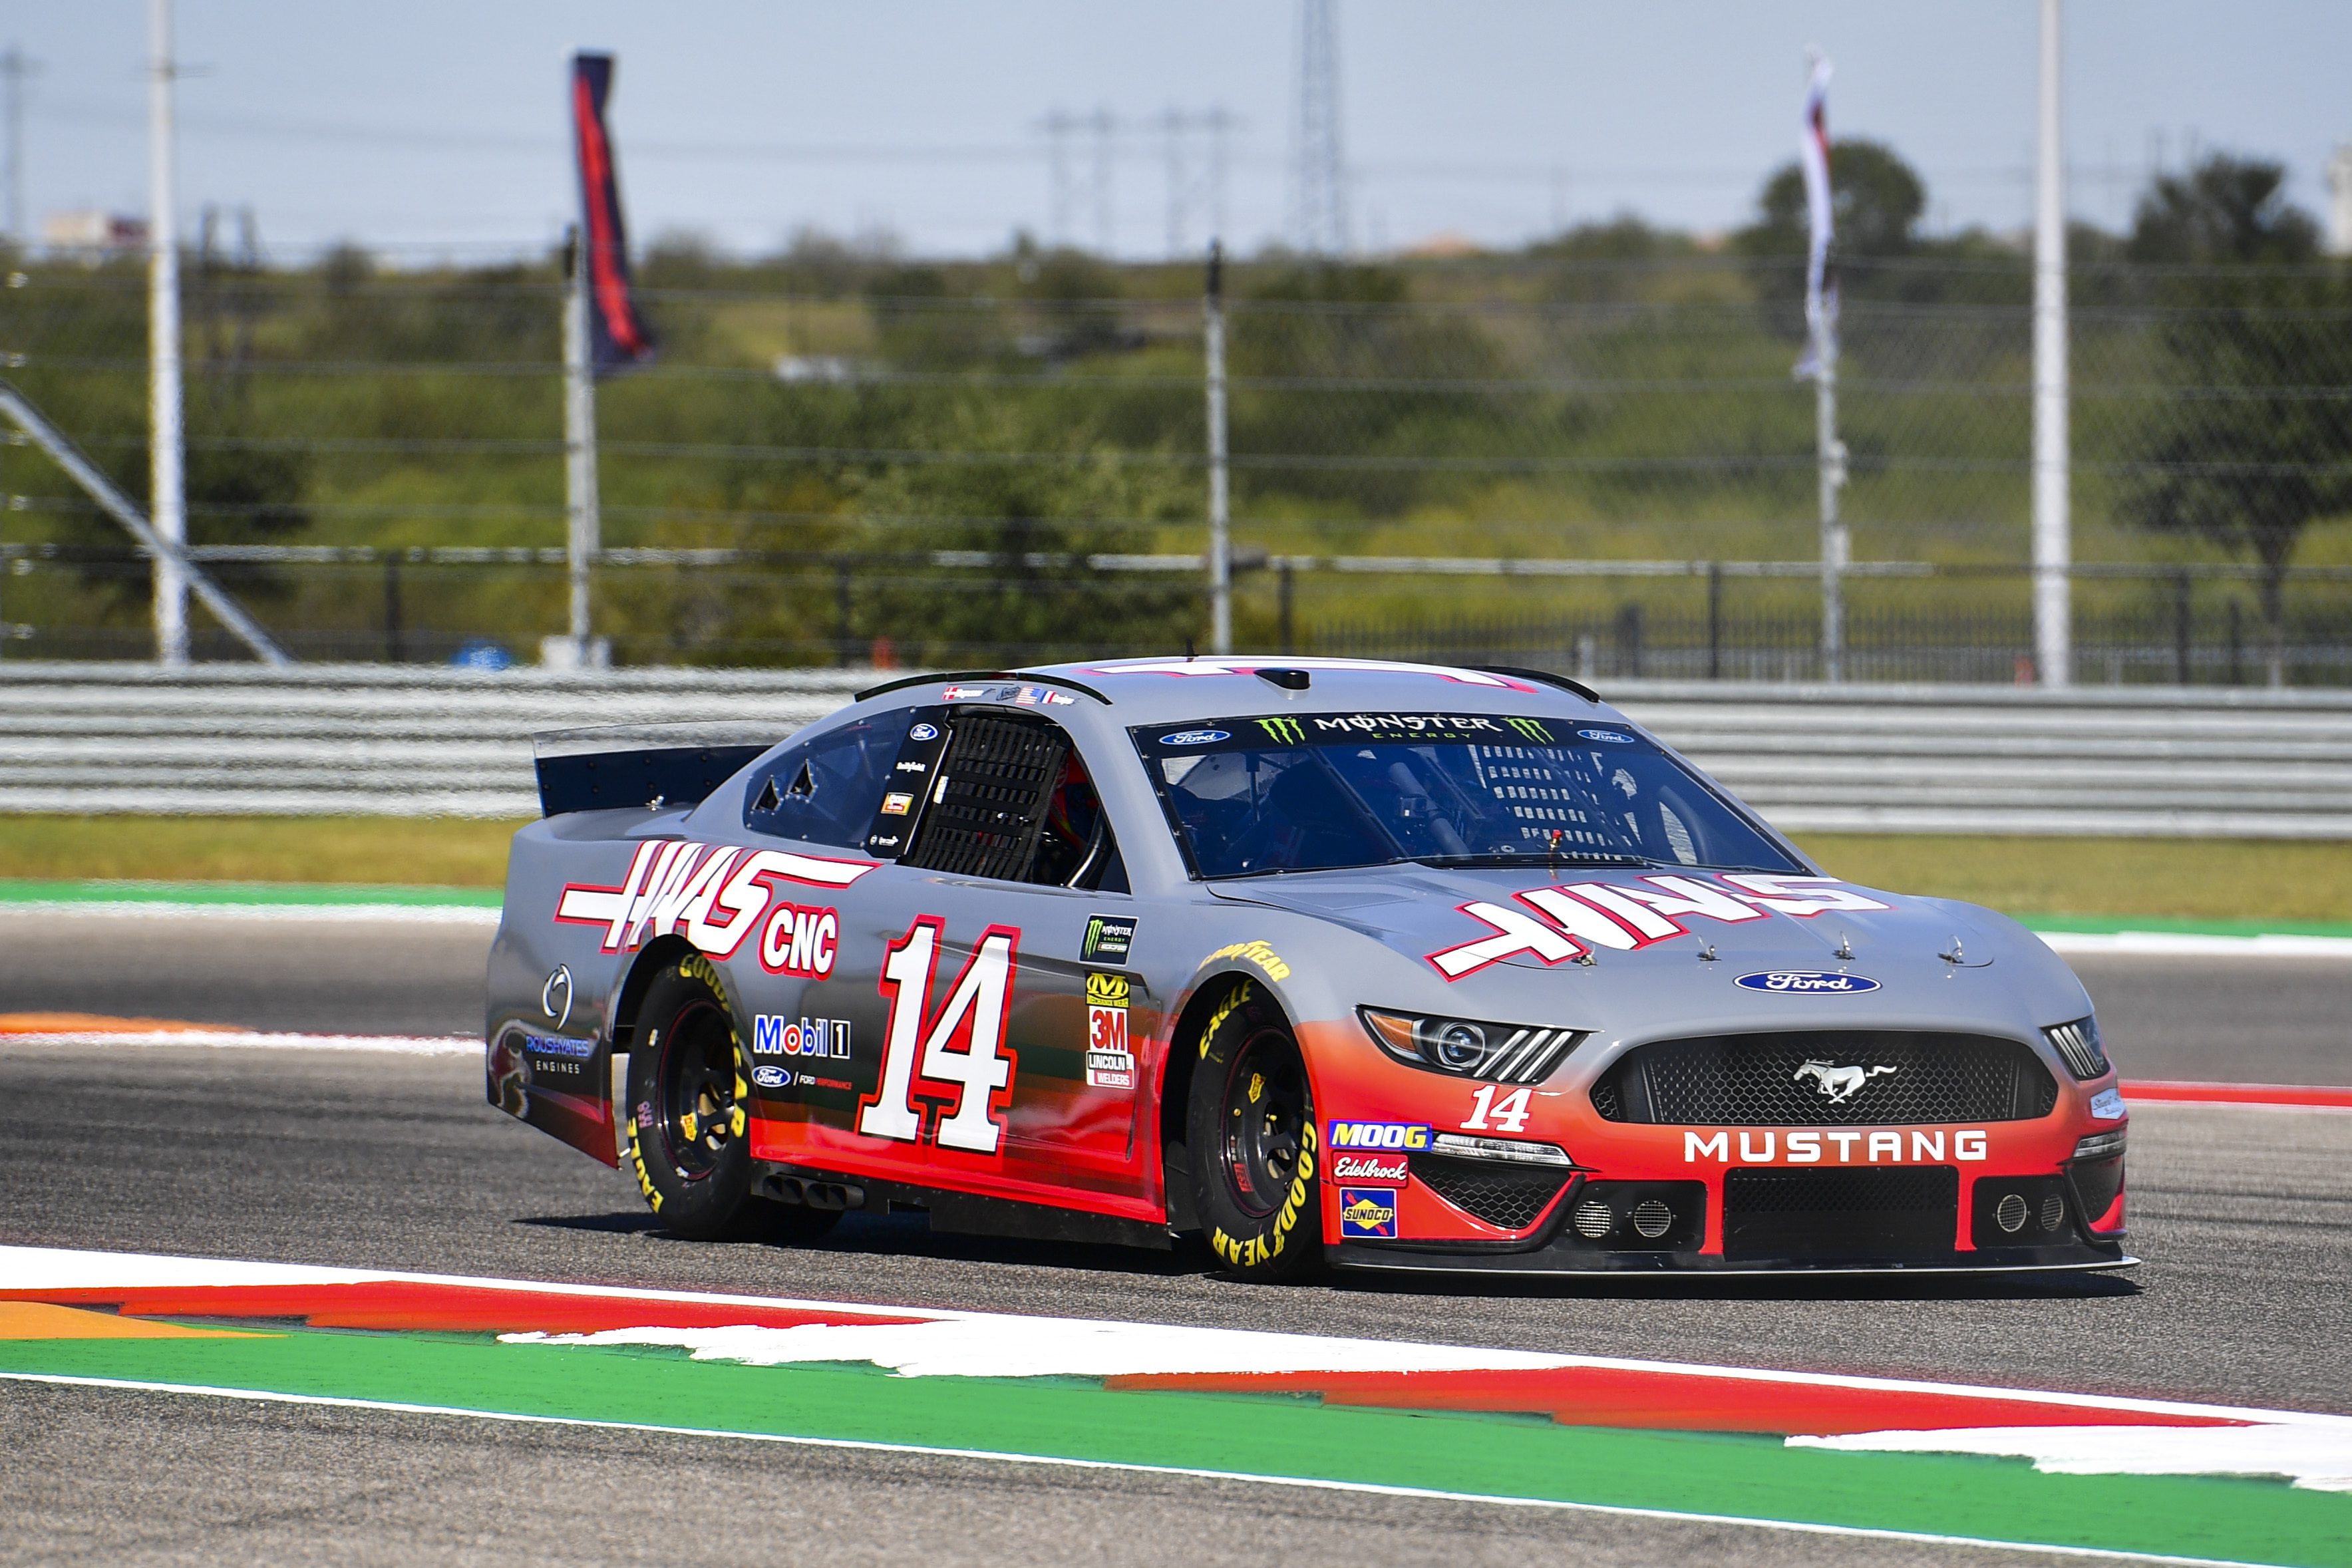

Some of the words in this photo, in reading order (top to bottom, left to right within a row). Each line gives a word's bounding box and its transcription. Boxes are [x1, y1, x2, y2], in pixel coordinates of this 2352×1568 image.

[1172, 731, 1218, 744] Ford
[761, 905, 836, 977] CNC
[1766, 969, 1854, 992] Ford
[753, 1014, 828, 1058] Mobil
[856, 918, 1018, 1156] 14
[1091, 1009, 1126, 1051] 3M
[535, 1059, 581, 1074] ENGINES
[1088, 1054, 1126, 1070] LINCOLN
[1096, 1072, 1130, 1086] WELDERS
[1460, 1084, 1532, 1133] 14
[1331, 1122, 1428, 1150] MOOG
[1683, 1129, 1987, 1163] MUSTANG
[1333, 1156, 1407, 1181] Edelbrock
[1212, 1120, 1317, 1267] GOODYEAR
[1344, 1208, 1392, 1222] SUNOCO
